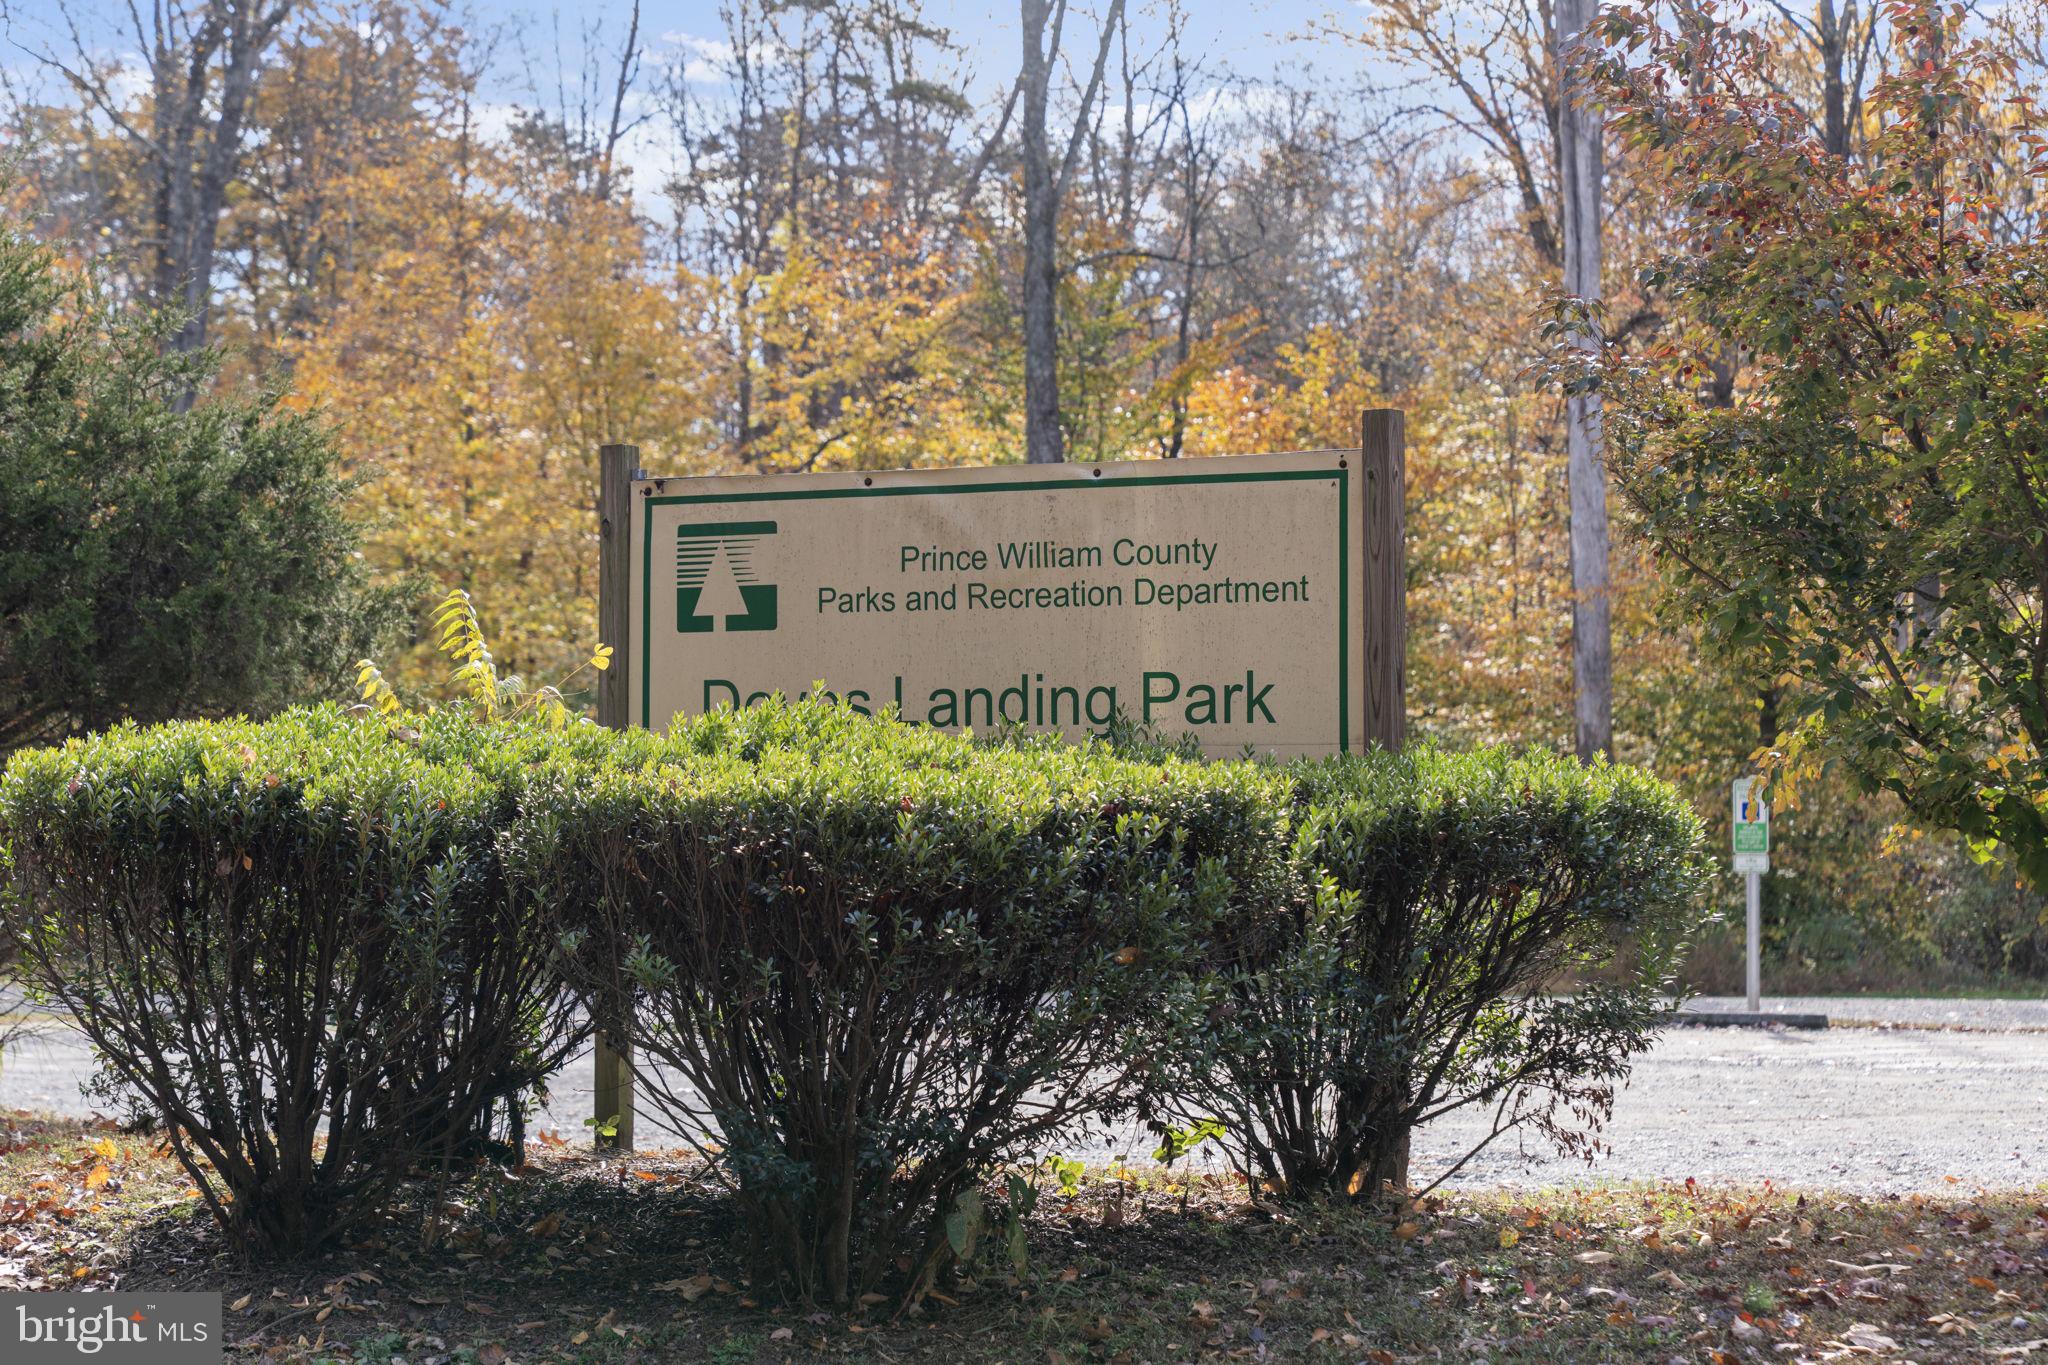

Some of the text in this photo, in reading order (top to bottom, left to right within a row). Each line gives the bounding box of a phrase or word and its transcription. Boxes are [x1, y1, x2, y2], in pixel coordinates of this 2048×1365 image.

[900, 538, 1218, 573] Prince William County
[818, 575, 1310, 613] Parks and Recreation Department
[894, 674, 1117, 738] Landing
[1142, 670, 1277, 725] Park
